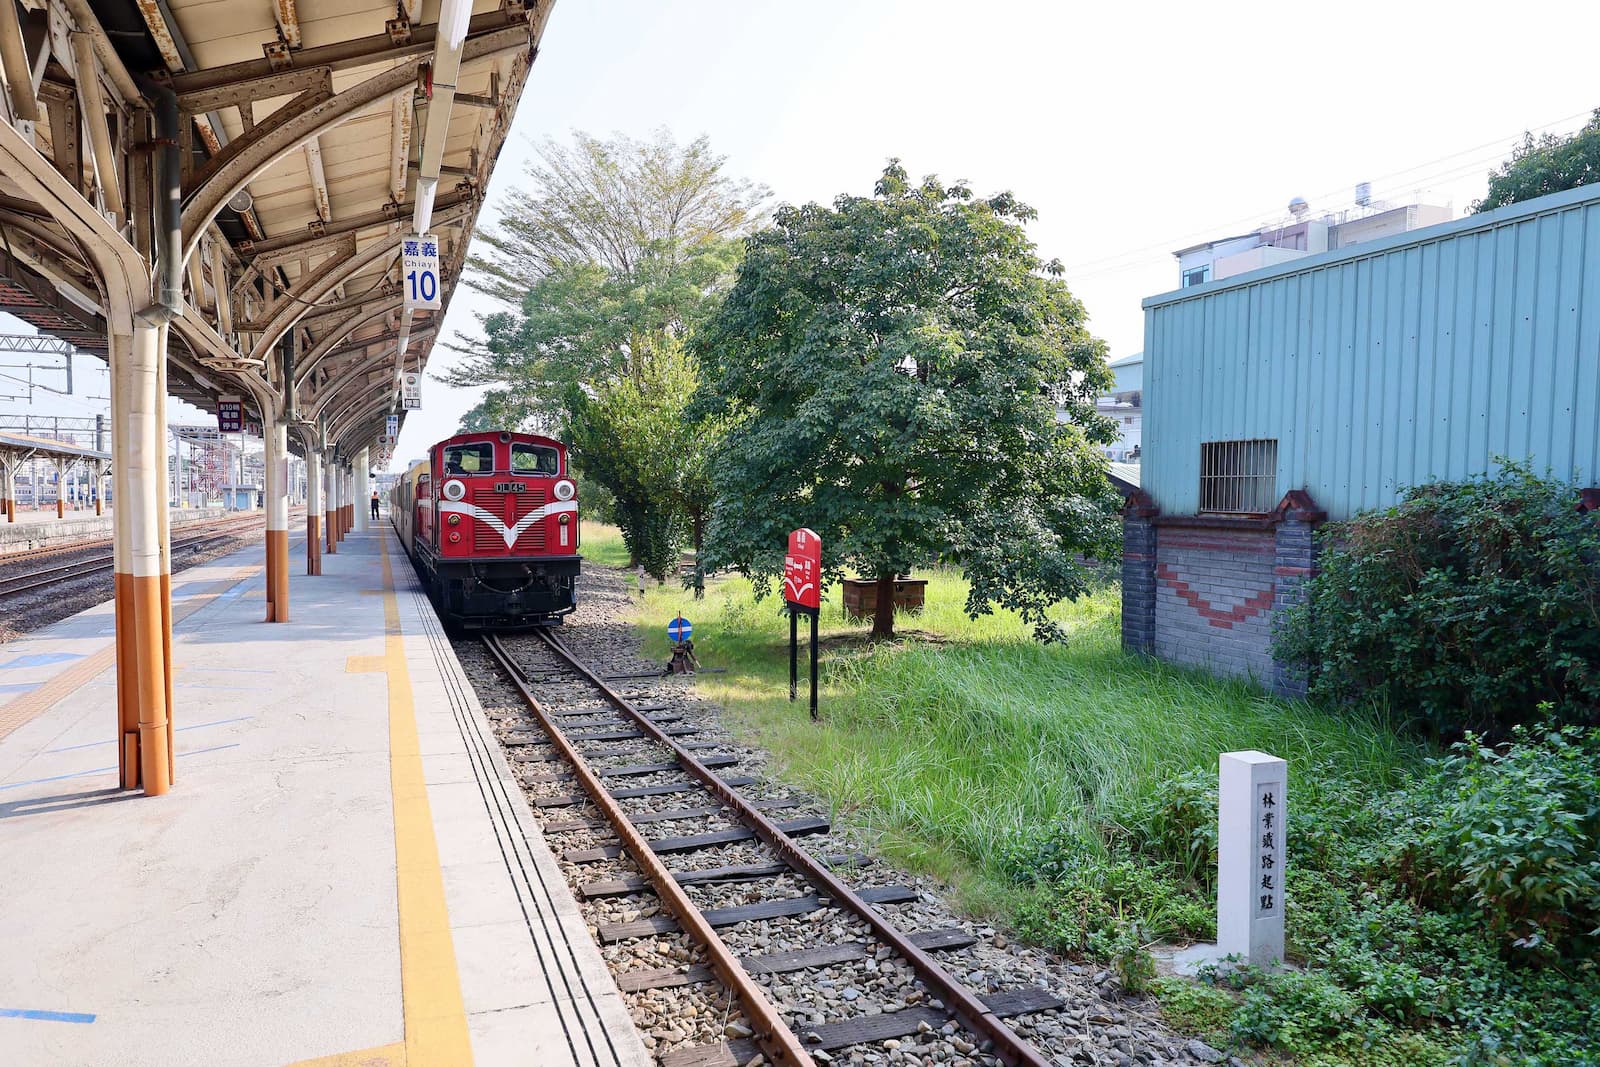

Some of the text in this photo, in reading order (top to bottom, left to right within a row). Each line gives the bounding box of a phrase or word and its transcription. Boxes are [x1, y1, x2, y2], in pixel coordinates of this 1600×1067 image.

[404, 241, 437, 257] 嘉義
[404, 260, 436, 269] Chiayi
[407, 270, 436, 301] 10
[1260, 791, 1276, 912] 林業鐵路起點
